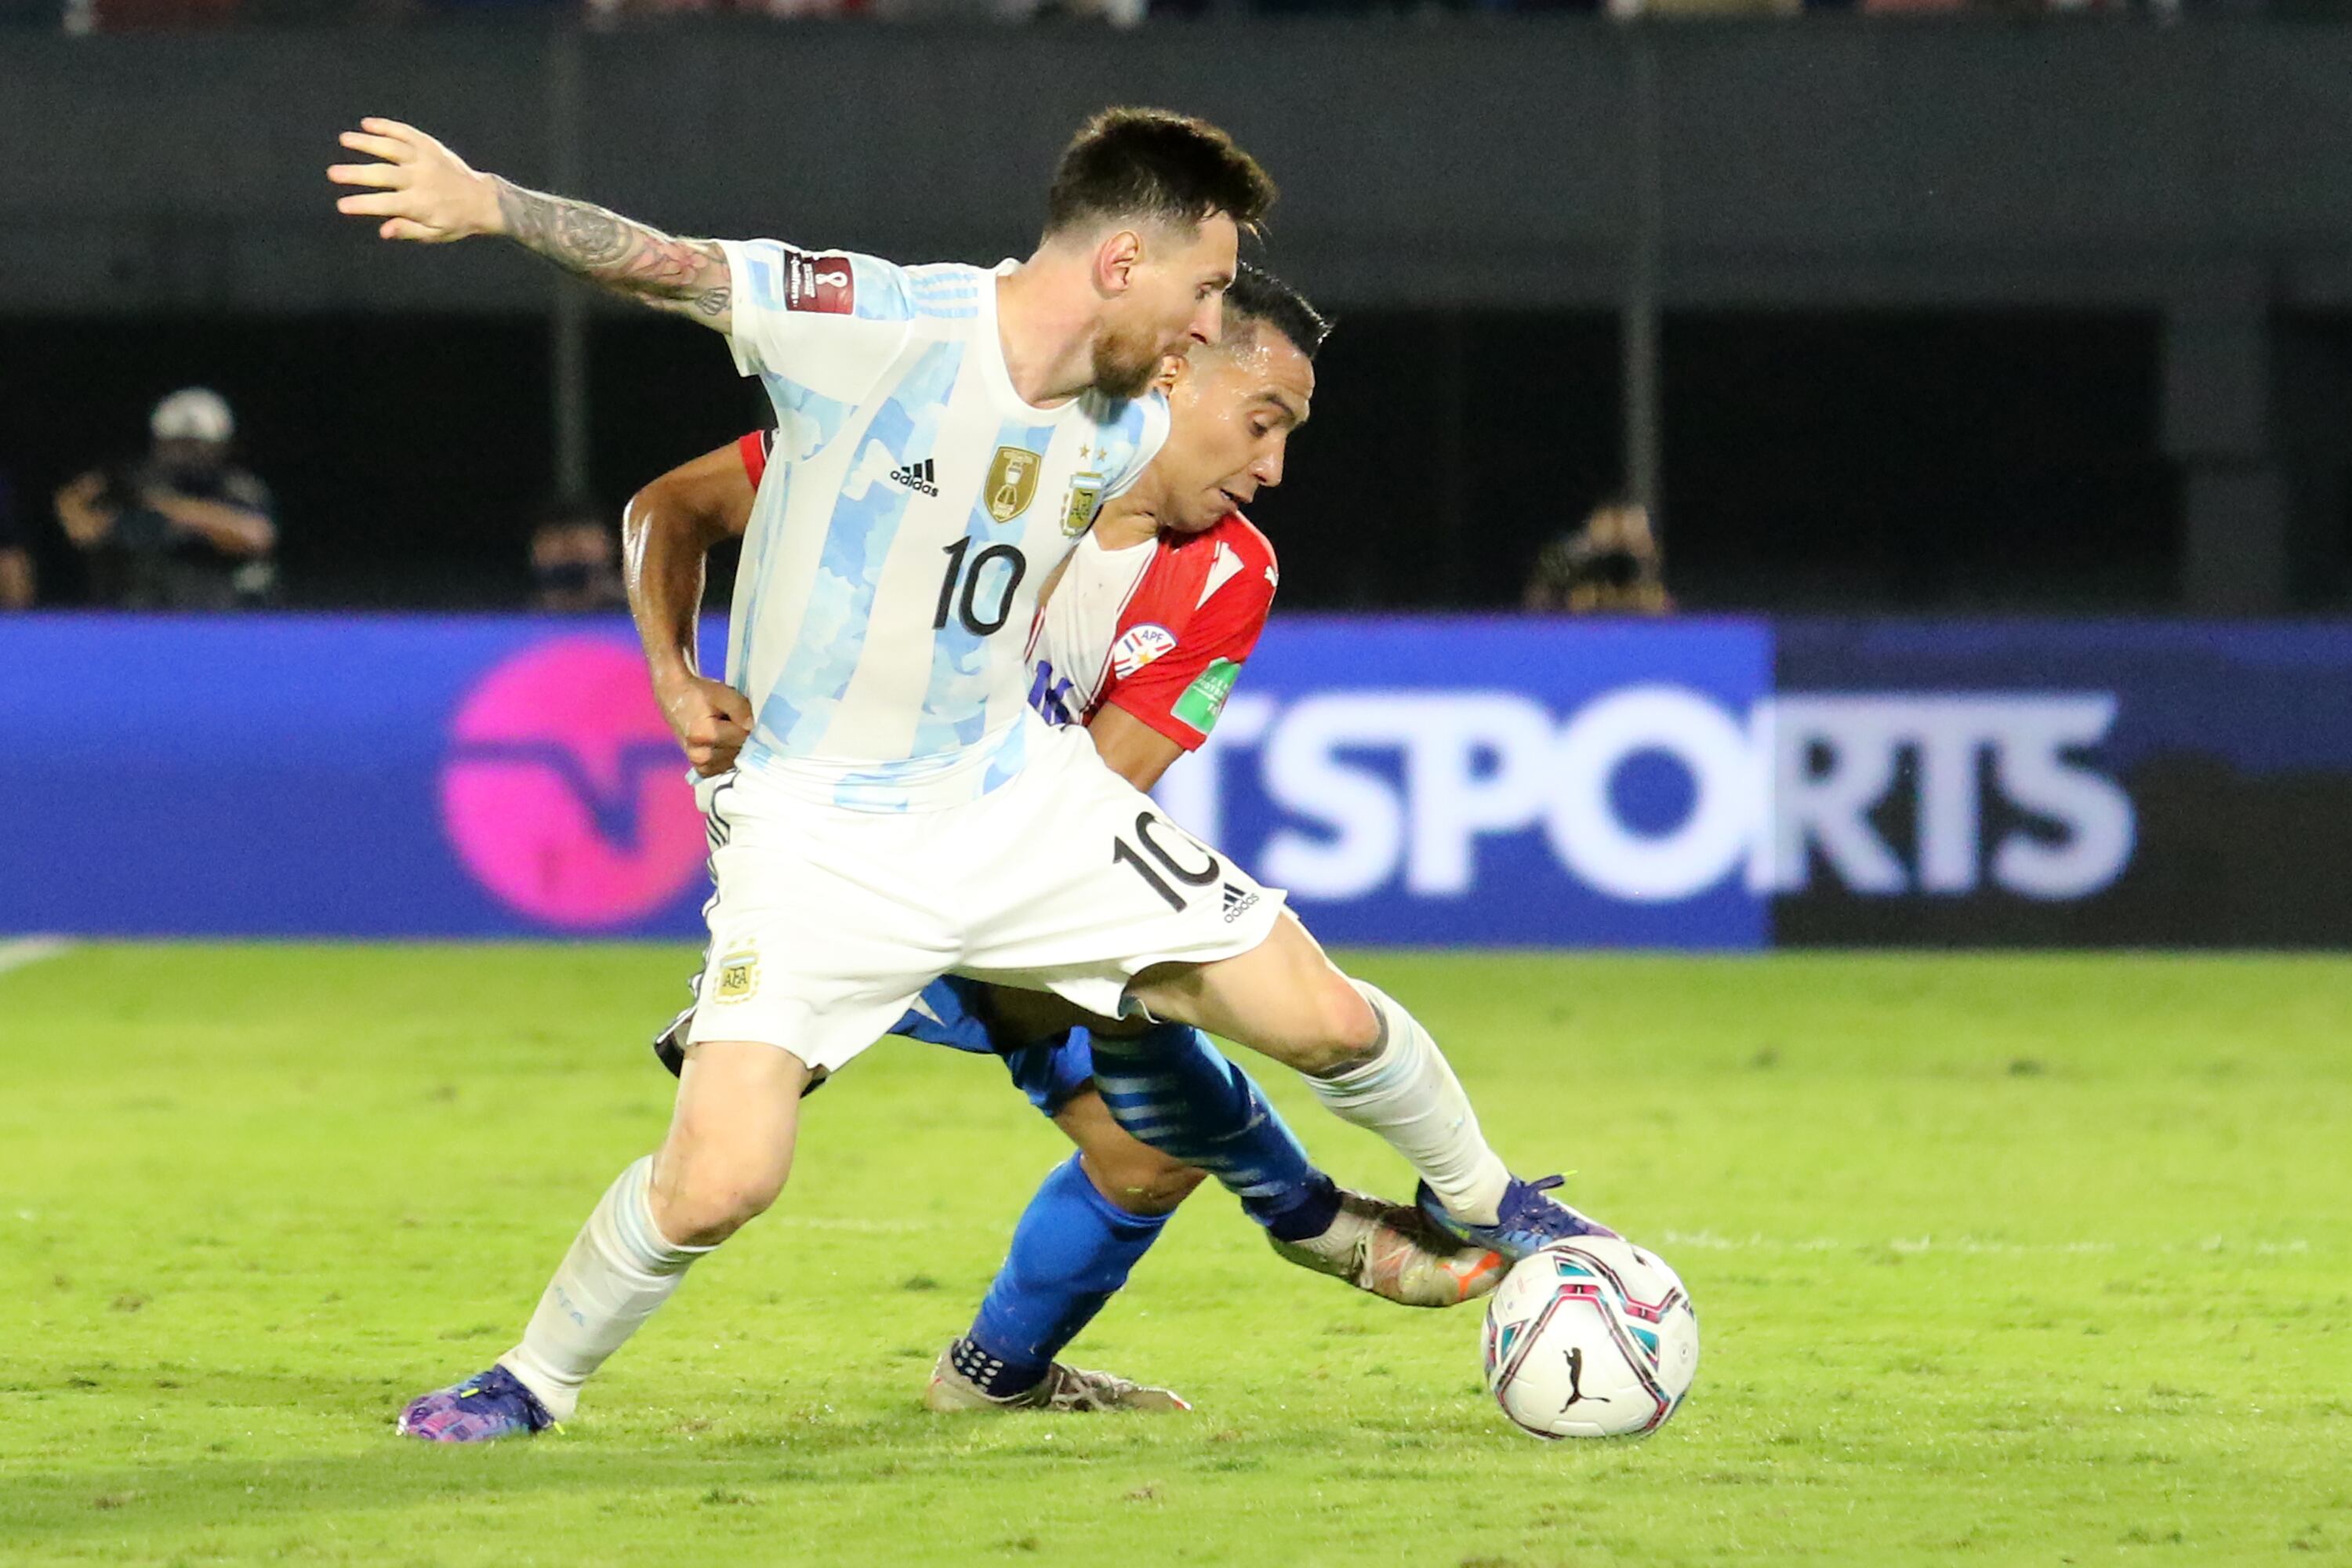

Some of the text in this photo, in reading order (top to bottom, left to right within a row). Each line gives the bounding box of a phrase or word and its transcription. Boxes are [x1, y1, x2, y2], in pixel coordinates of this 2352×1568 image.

[890, 470, 939, 497] adidas
[931, 535, 1026, 636] 10
[1141, 630, 1165, 643] APF
[1112, 811, 1220, 913] 10
[1224, 892, 1260, 924] adidas
[722, 966, 748, 989] AFA
